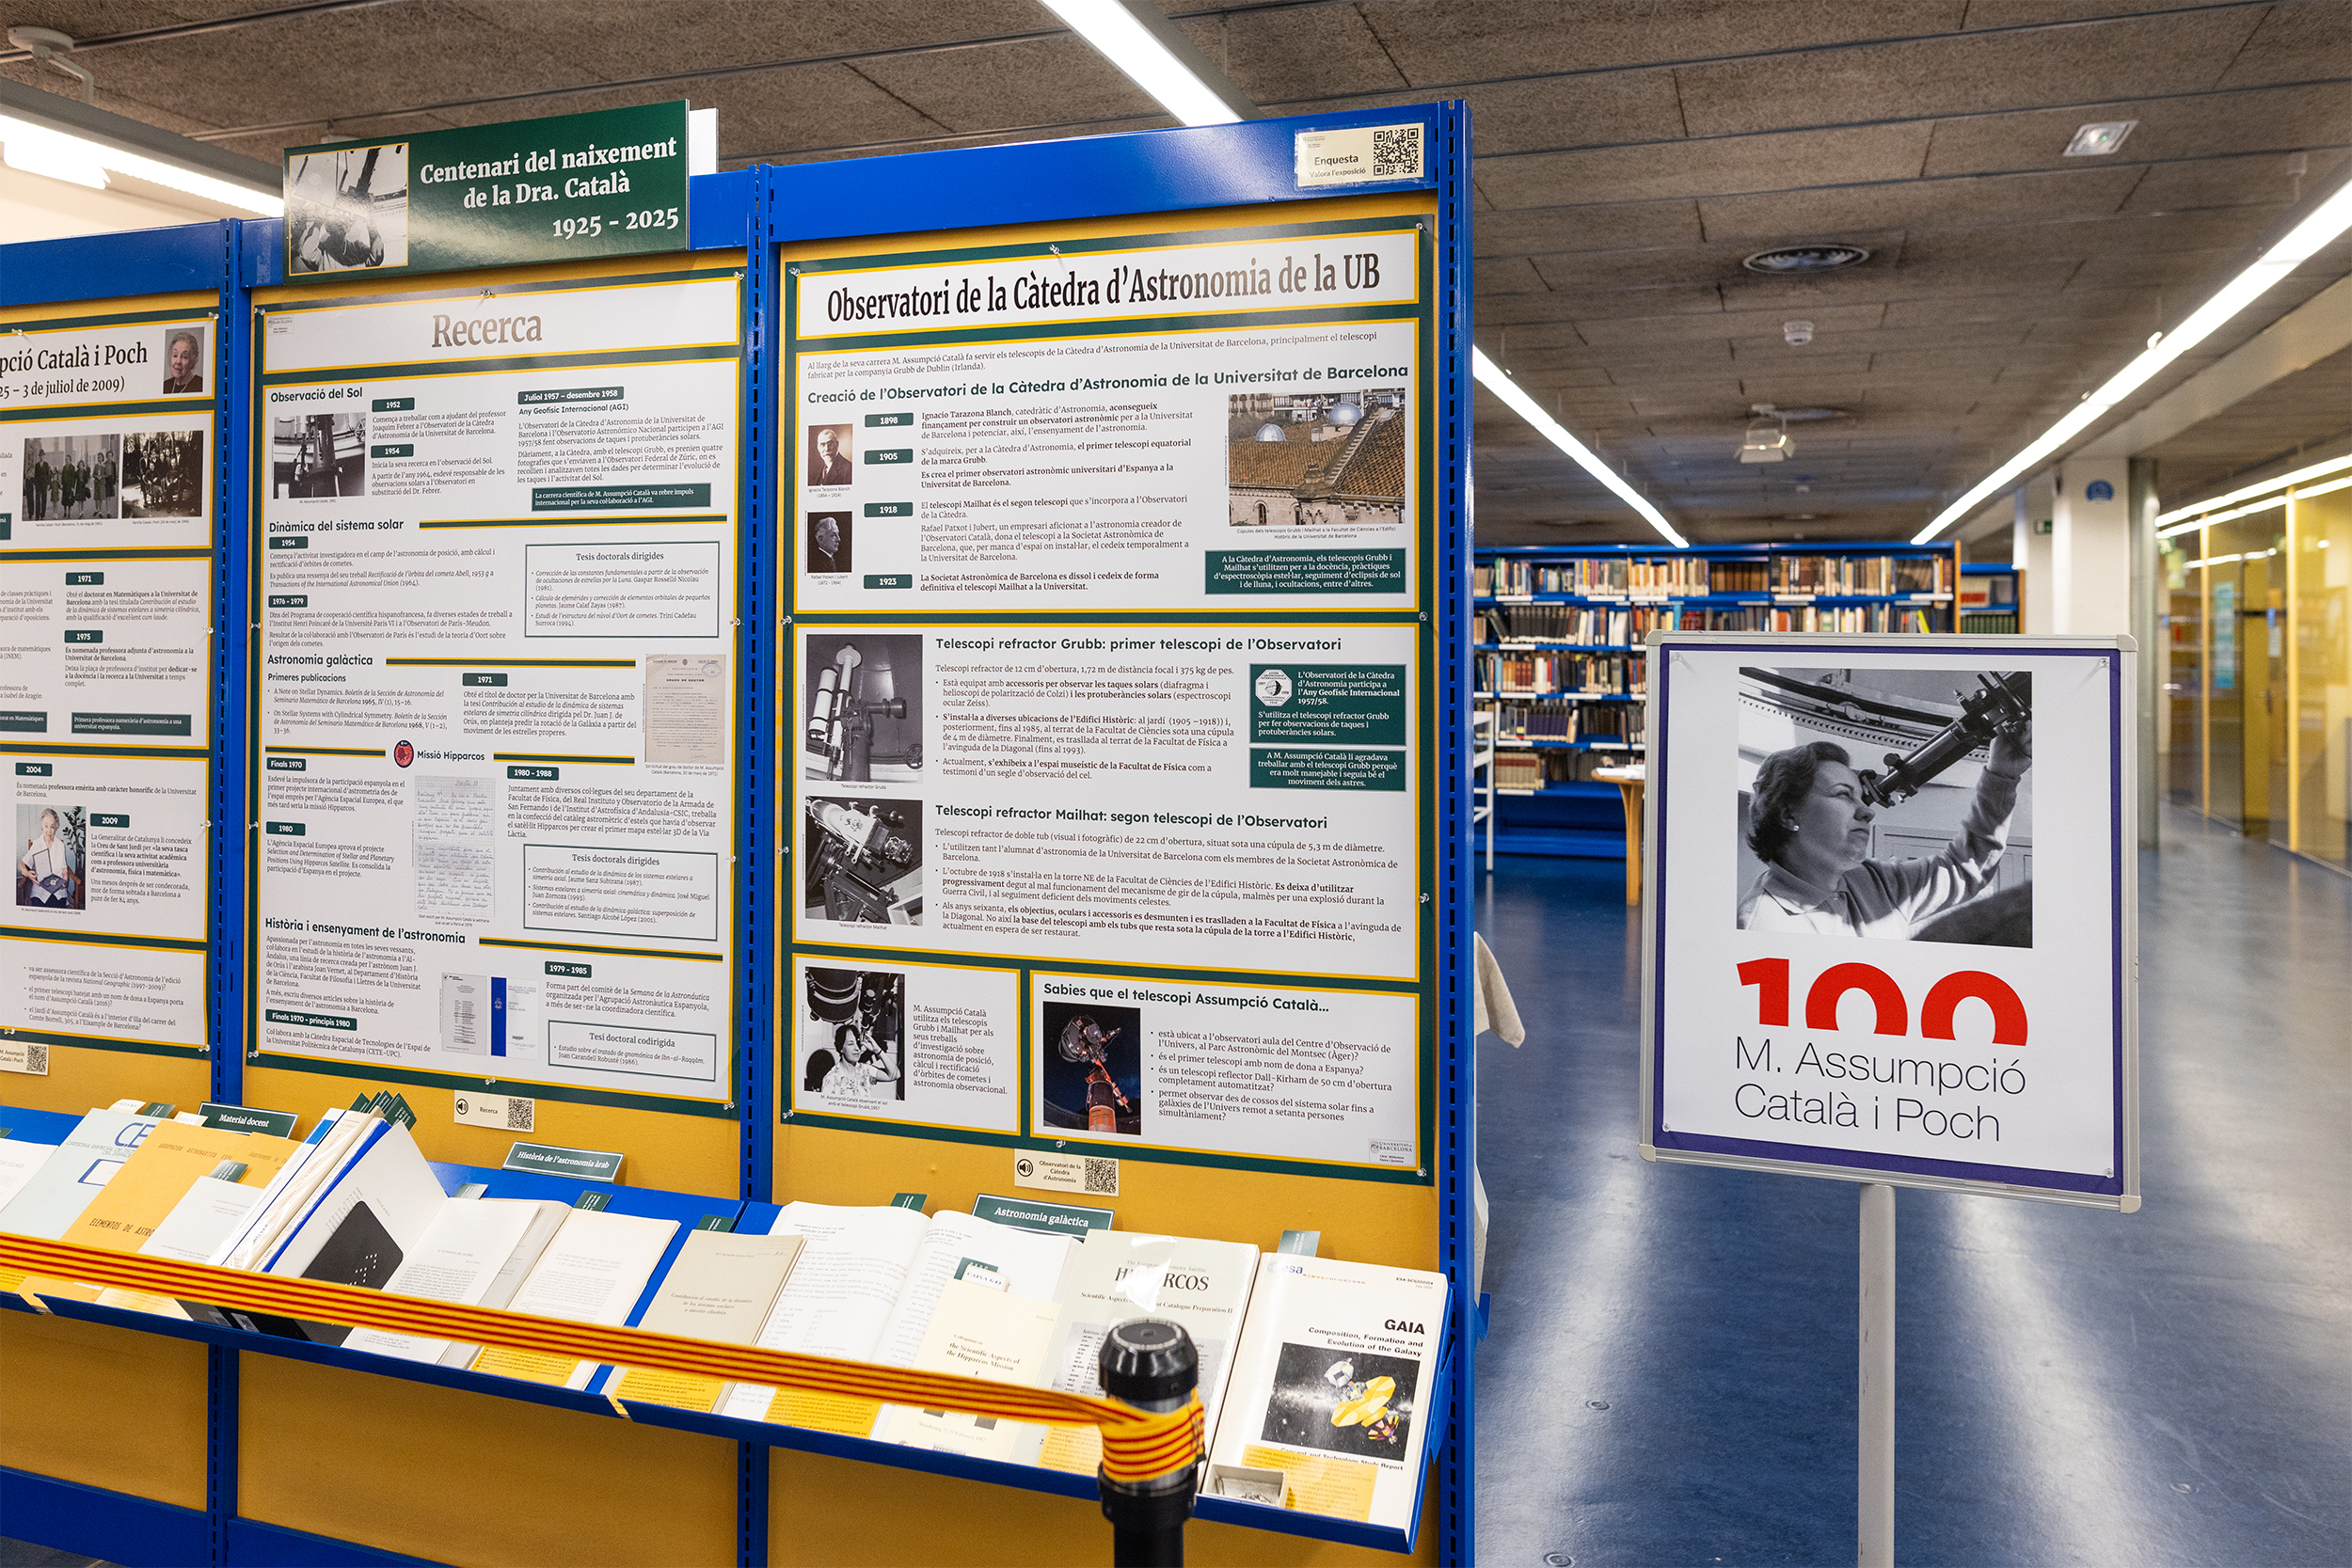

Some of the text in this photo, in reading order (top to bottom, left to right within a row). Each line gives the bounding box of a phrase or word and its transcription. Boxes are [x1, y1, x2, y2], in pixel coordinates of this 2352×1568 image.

[420, 136, 677, 184] Centenari del naixement
[1314, 154, 1359, 166] Enquesta
[463, 169, 630, 209] de la Dra. Català
[552, 214, 602, 240] 1925
[625, 207, 679, 230] 2025
[827, 253, 1380, 322] Observatori de la Càtedra d'Astronomia de la UB
[431, 314, 543, 348] Recerca
[37, 343, 90, 371] Català
[93, 344, 100, 366] i
[103, 341, 148, 366] Poch
[23, 384, 28, 399] 3
[30, 380, 43, 395] de
[44, 378, 73, 398] juliol
[75, 377, 89, 392] de
[91, 375, 125, 393] 2009)
[807, 364, 1408, 404] Creació de l'Observatori de la Càtedra d'Astronomia de la Universitat de Barcelona
[270, 386, 363, 403] Observació del Sol
[523, 392, 543, 402] Juliol
[543, 392, 560, 401] 1957
[565, 390, 600, 399] desembre
[601, 389, 618, 398] 1958
[386, 401, 401, 409] 1952
[518, 403, 629, 417] Any Geofísic Internacional (AGI)
[880, 416, 898, 425] 1898
[385, 447, 400, 455] 1954
[879, 452, 898, 461] 1905
[921, 470, 930, 479] Es
[946, 469, 955, 478] el
[955, 469, 981, 480] primer
[981, 467, 1025, 477] observatori
[1025, 466, 1070, 475] astronòmic
[1071, 465, 1117, 474] universitari
[1117, 464, 1158, 474] d'Espanya
[1166, 463, 1174, 471] la
[920, 478, 1011, 489] Universitat de Barcelona.
[880, 505, 898, 514] 1918
[269, 518, 405, 532] Dinàmica del sistema solar
[76, 632, 91, 641] 1975
[935, 637, 1342, 653] Telescopi refractor Grubb: primer telescopi de l'Observatori
[267, 653, 373, 668] Astronomia galàctica
[477, 675, 492, 684] 1971
[270, 759, 288, 768] Finals
[417, 750, 485, 762] Missió Hipparcos
[514, 768, 531, 777] 1980
[102, 816, 119, 825] 2009
[935, 804, 1327, 829] Telescopi refractor Mailhat: segon telescopi de l'Observatori
[264, 916, 466, 943] Història i ensenyament de l'astronomia
[1043, 983, 1329, 1012] Sabies que el telescopi Assumpció Català...
[1736, 957, 2028, 1047] 100
[1737, 1036, 2026, 1096] M. Assumpció
[479, 1106, 498, 1115] Recerca
[1735, 1083, 1999, 1142] Català i Poch
[218, 1114, 270, 1128] Material docent
[516, 1150, 610, 1168] Història de l'astronomia àrab
[993, 1206, 1089, 1227] Astronomia galàctica
[88, 1217, 122, 1230] ELEMENTOS
[122, 1223, 134, 1233] DE
[1384, 1319, 1425, 1335] GAIA
[1308, 1326, 1360, 1340] Composition,
[1363, 1334, 1406, 1345] Formation
[1327, 1338, 1365, 1349] Evolution
[1393, 1346, 1422, 1357] Galaxy
